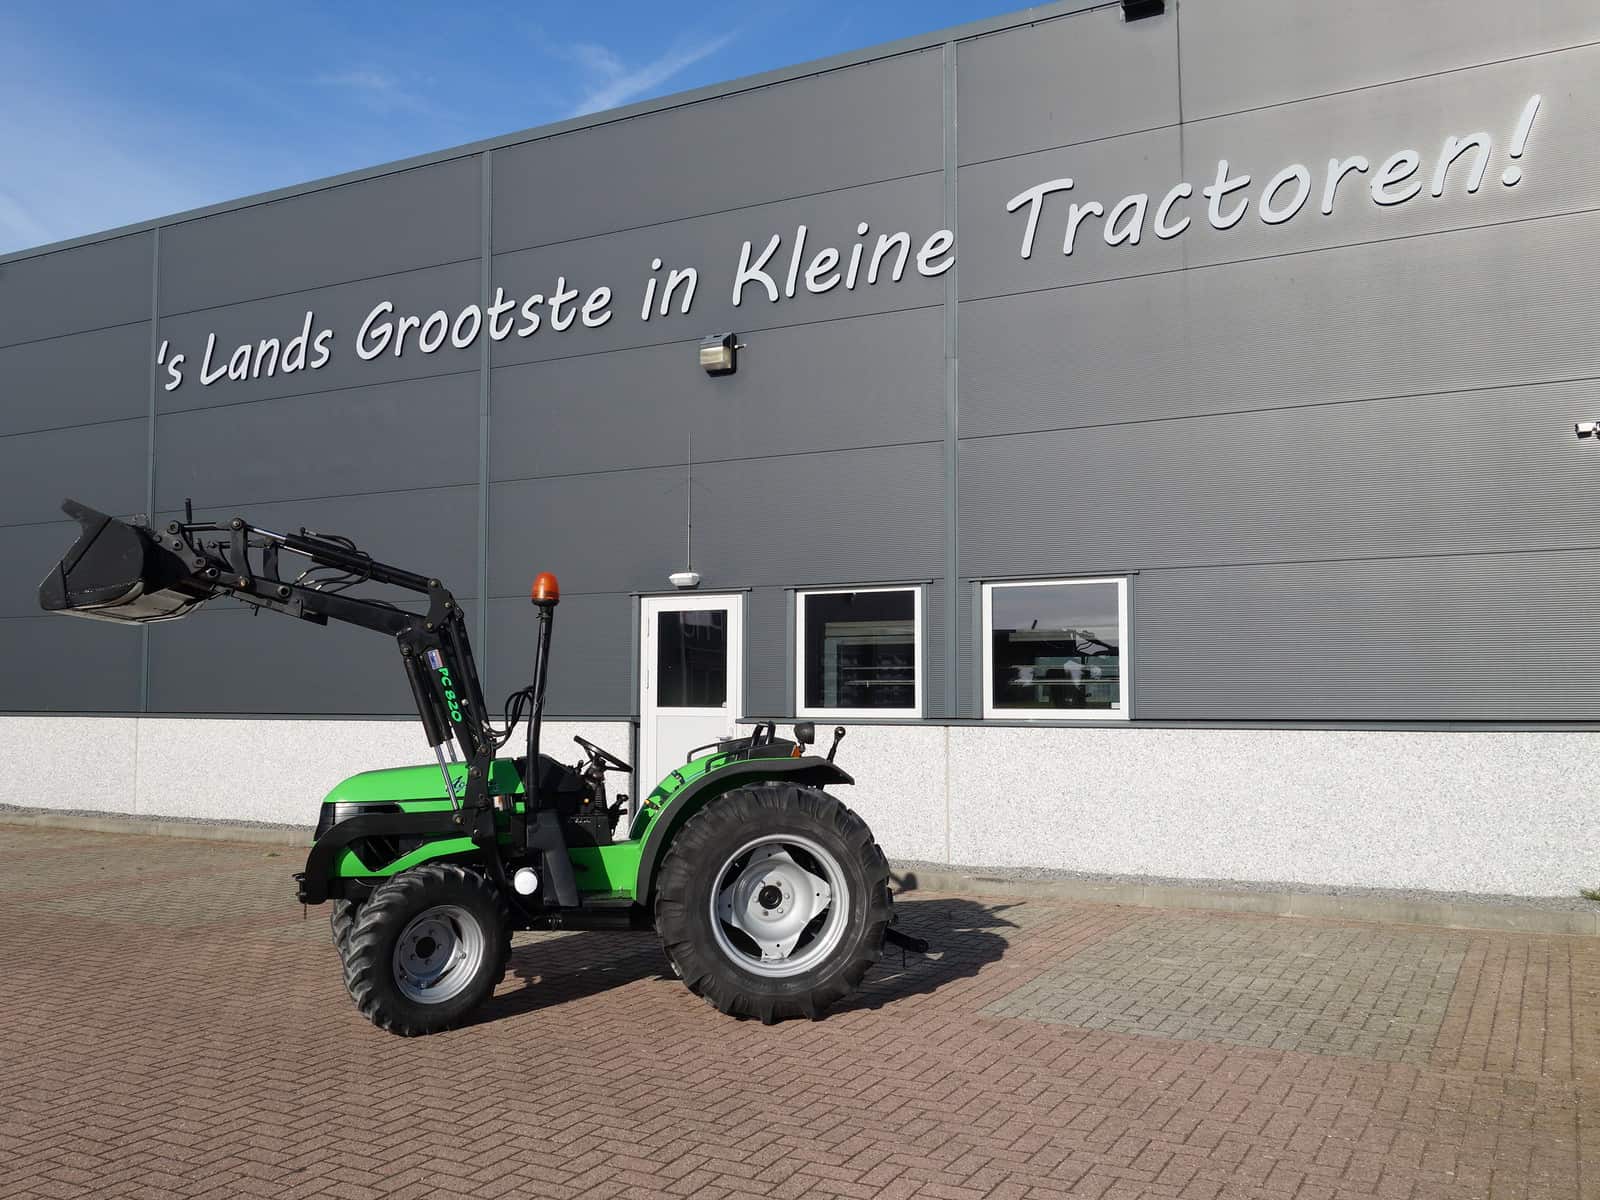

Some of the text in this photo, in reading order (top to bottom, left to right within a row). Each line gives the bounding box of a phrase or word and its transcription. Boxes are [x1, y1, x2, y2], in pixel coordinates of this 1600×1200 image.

[157, 94, 1541, 391] 's Lands Grootste in Kleine Tractoren!
